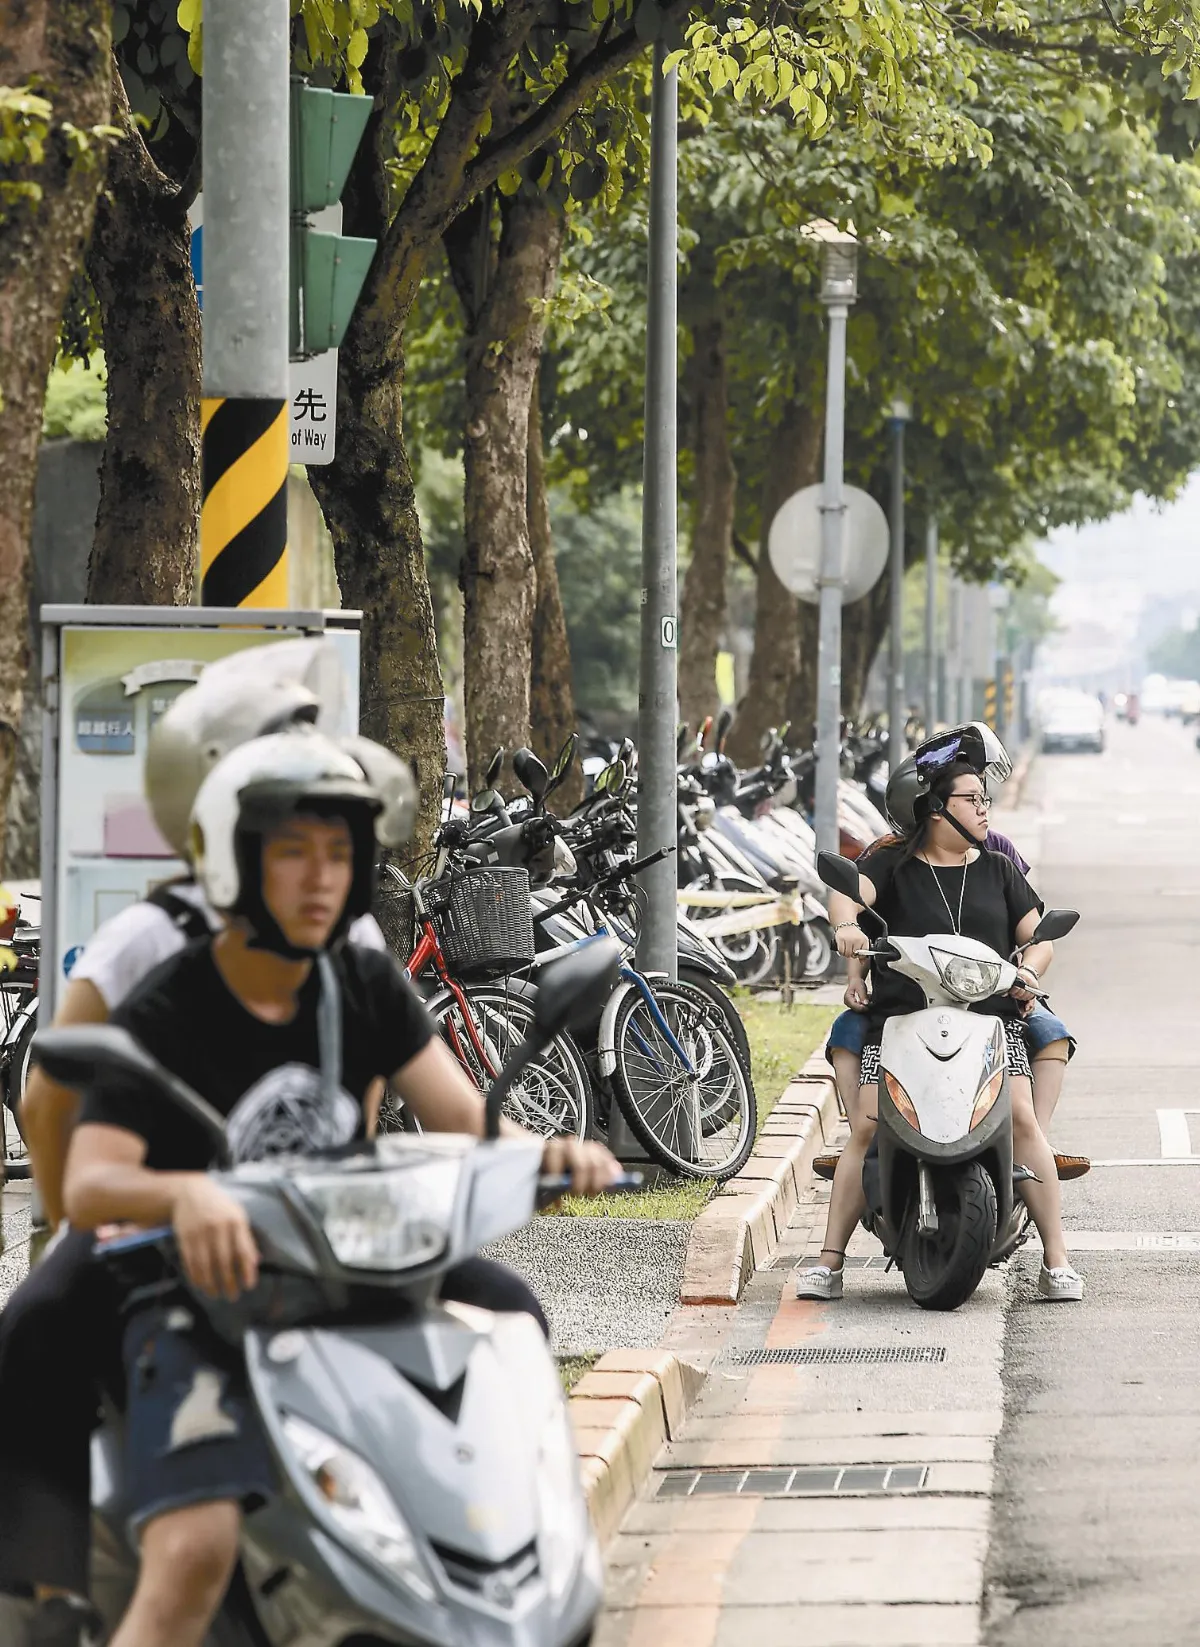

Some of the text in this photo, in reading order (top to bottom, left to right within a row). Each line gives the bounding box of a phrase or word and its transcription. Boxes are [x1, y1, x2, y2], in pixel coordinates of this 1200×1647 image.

[294, 388, 327, 421] 先
[292, 429, 326, 450] of Way
